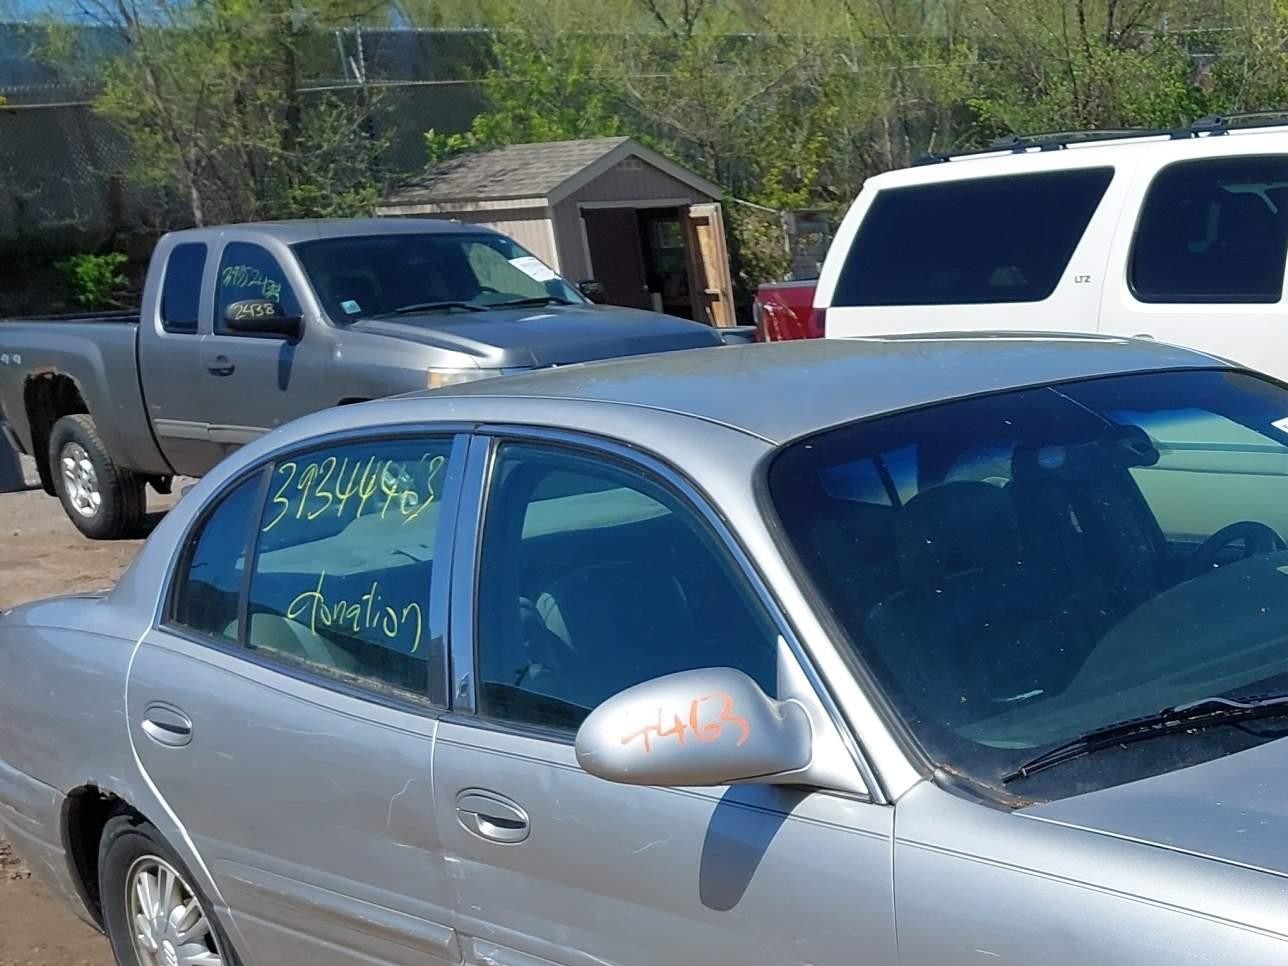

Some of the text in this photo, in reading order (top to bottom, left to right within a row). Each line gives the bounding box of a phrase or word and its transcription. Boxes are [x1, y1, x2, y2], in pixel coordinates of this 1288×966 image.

[1074, 275, 1091, 284] LTZ
[261, 453, 446, 533] 39344463
[285, 569, 422, 654] donation
